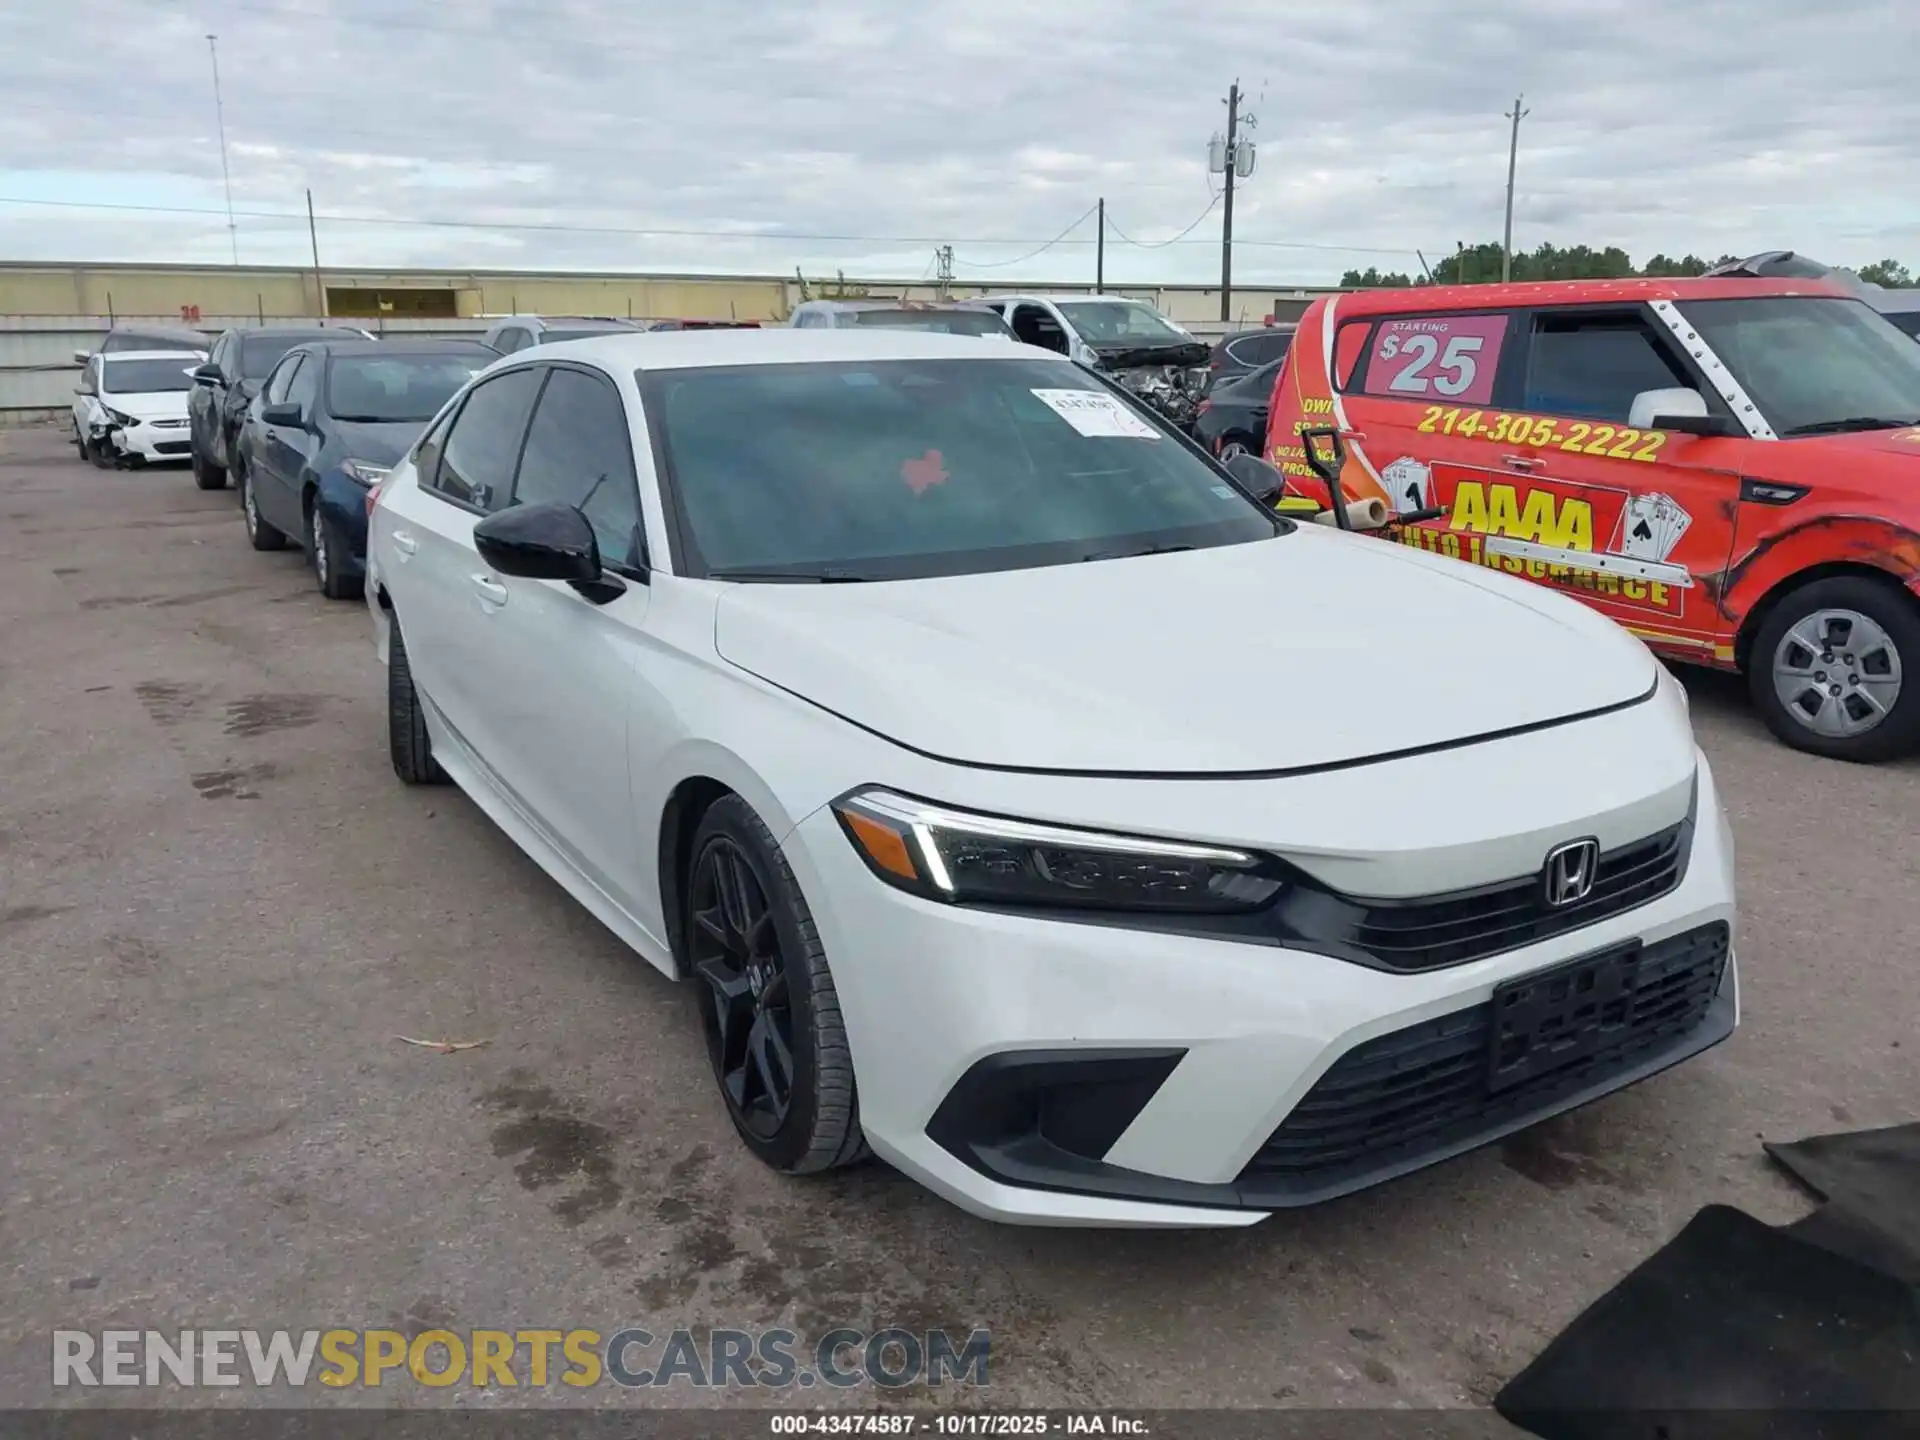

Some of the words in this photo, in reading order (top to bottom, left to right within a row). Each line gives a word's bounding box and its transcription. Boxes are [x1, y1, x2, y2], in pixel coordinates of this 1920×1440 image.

[1391, 322, 1448, 332] STARTING
[1379, 333, 1484, 395] $25
[1303, 398, 1333, 414] DWI
[1417, 406, 1667, 463] 214-305-2222
[1449, 480, 1593, 552] AAAA
[1403, 524, 1460, 560] UTO
